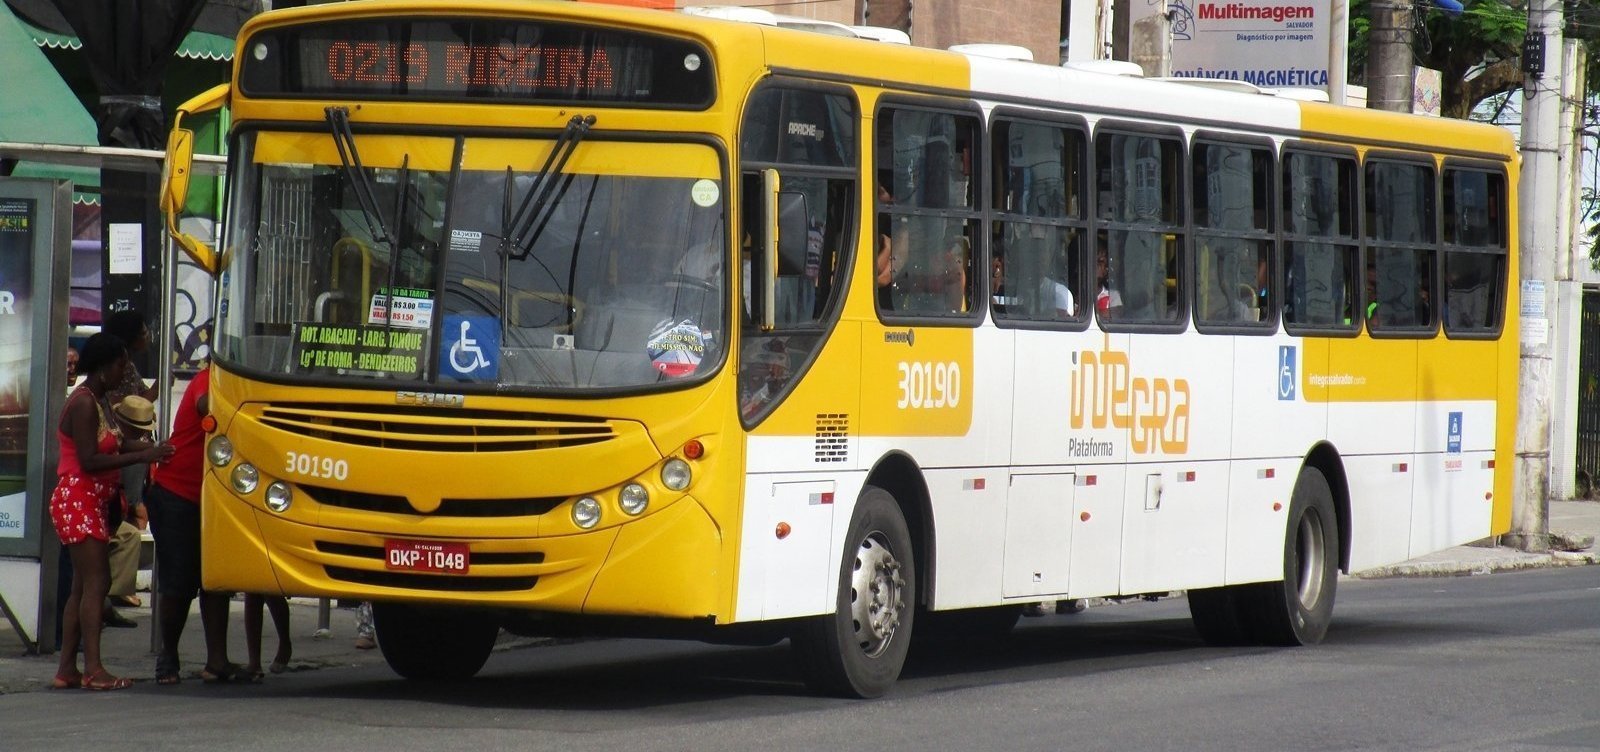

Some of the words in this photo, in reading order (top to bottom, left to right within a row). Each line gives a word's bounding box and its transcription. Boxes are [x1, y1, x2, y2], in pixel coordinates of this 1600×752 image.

[1198, 2, 1314, 22] Multimagem
[1236, 33, 1274, 42] Diagnóstico
[1275, 34, 1286, 42] por
[1286, 34, 1314, 42] imagem
[328, 41, 428, 83] 0219
[446, 45, 613, 88] RIBEIRA
[1244, 67, 1329, 86] MAGNÉTICA
[788, 122, 816, 136] APACHE
[0, 290, 16, 315] R
[409, 290, 429, 298] TARIFA
[393, 301, 402, 309] R$
[300, 326, 318, 343] ROT.
[320, 327, 357, 345] ABACAXI
[362, 330, 386, 347] LARG.
[389, 331, 423, 351] TANQUE
[315, 350, 327, 367] DE
[327, 351, 353, 368] ROMA
[359, 353, 417, 373] DENDEZEIROS
[897, 361, 960, 409] 30190
[1068, 437, 1113, 457] Plataforma
[285, 451, 348, 481] 30190
